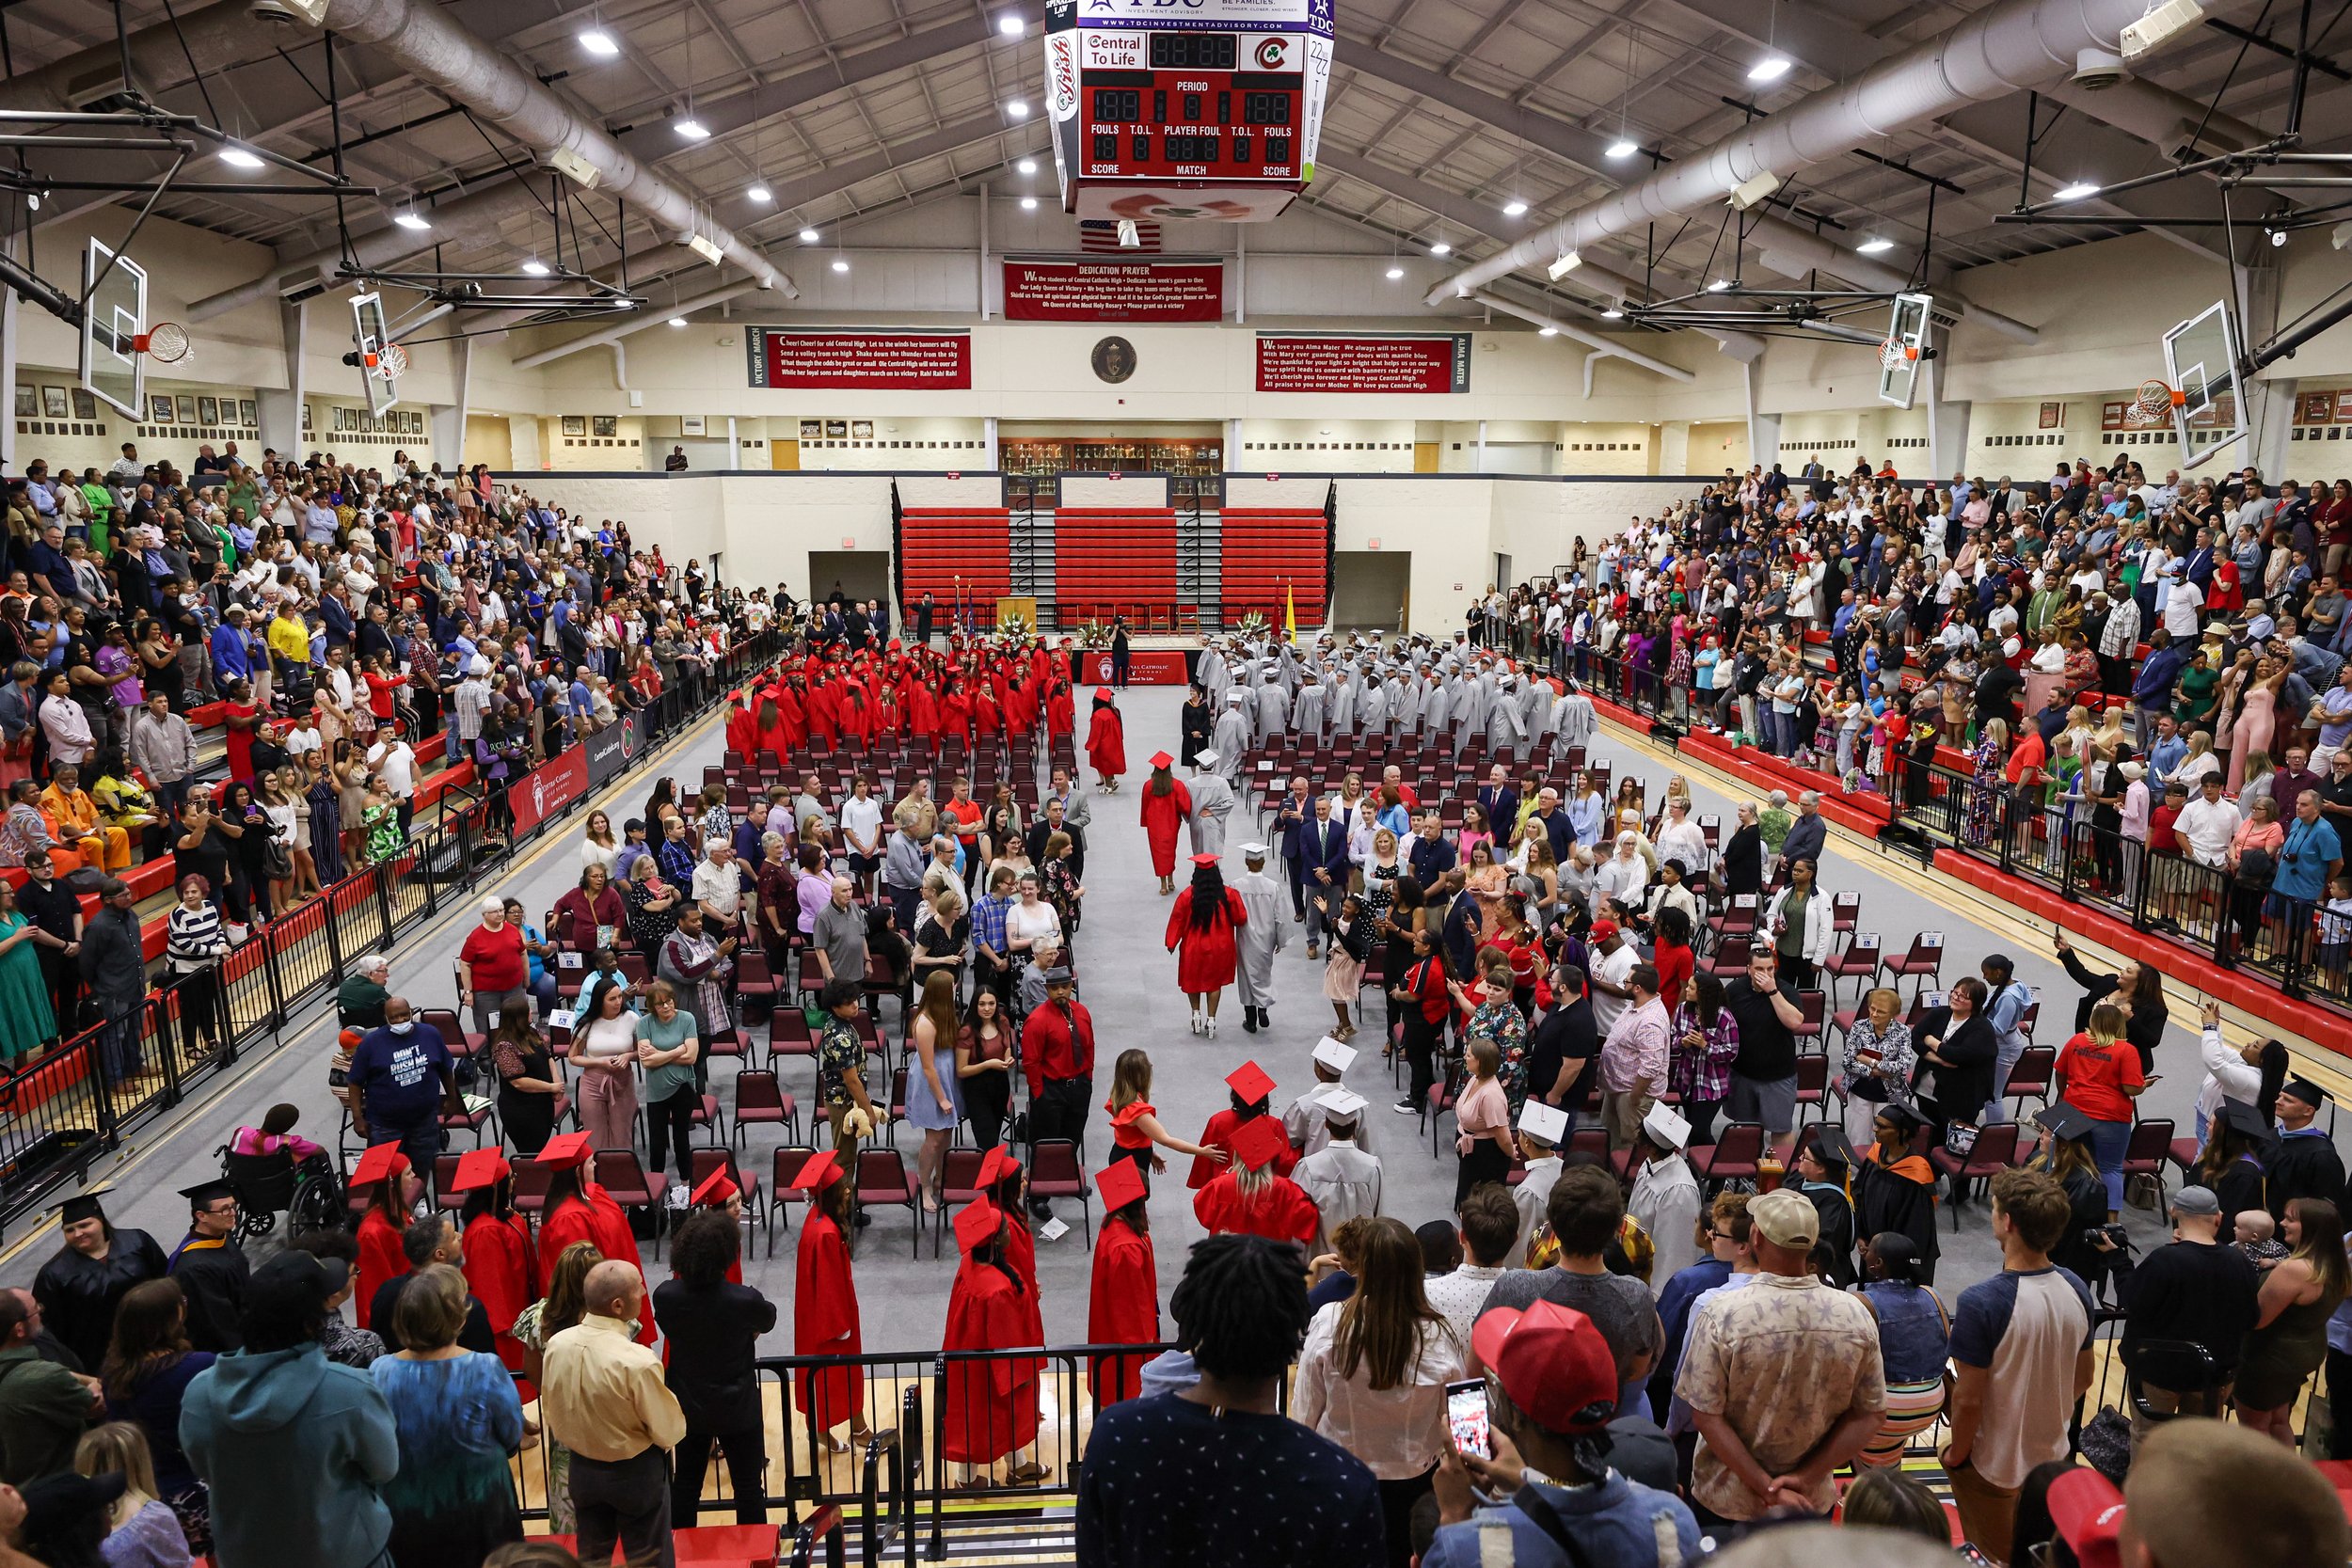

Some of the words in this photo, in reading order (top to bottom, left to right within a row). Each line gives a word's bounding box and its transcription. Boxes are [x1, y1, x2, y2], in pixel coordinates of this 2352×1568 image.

[1054, 5, 1068, 14] LAW
[1103, 20, 1282, 29] WWW.TDCINVESTMENTADVISORY.COM
[1310, 13, 1334, 33] TDC
[1088, 35, 1139, 50] Central
[1091, 53, 1107, 65] To
[1111, 52, 1136, 65] Life
[1177, 81, 1208, 91] PERIOD
[1091, 125, 1119, 135] FOULS
[1130, 125, 1153, 135] T.O.L.
[1165, 126, 1197, 135] PLAYER
[1200, 126, 1221, 136] FOUL
[1232, 127, 1254, 136] T.O.L.
[1264, 127, 1292, 136] FOULS
[1091, 165, 1119, 174] SCORE
[1177, 166, 1206, 176] MATCH
[1263, 166, 1290, 177] SCORE
[1079, 266, 1120, 275] DEDICATION
[752, 327, 761, 353] MARCH
[780, 336, 799, 346] Cheer!
[1263, 340, 1276, 350] We
[754, 355, 763, 384] VICTORY
[1456, 360, 1465, 385] MATER
[393, 1044, 420, 1063] DON'T
[415, 1053, 428, 1068] ME
